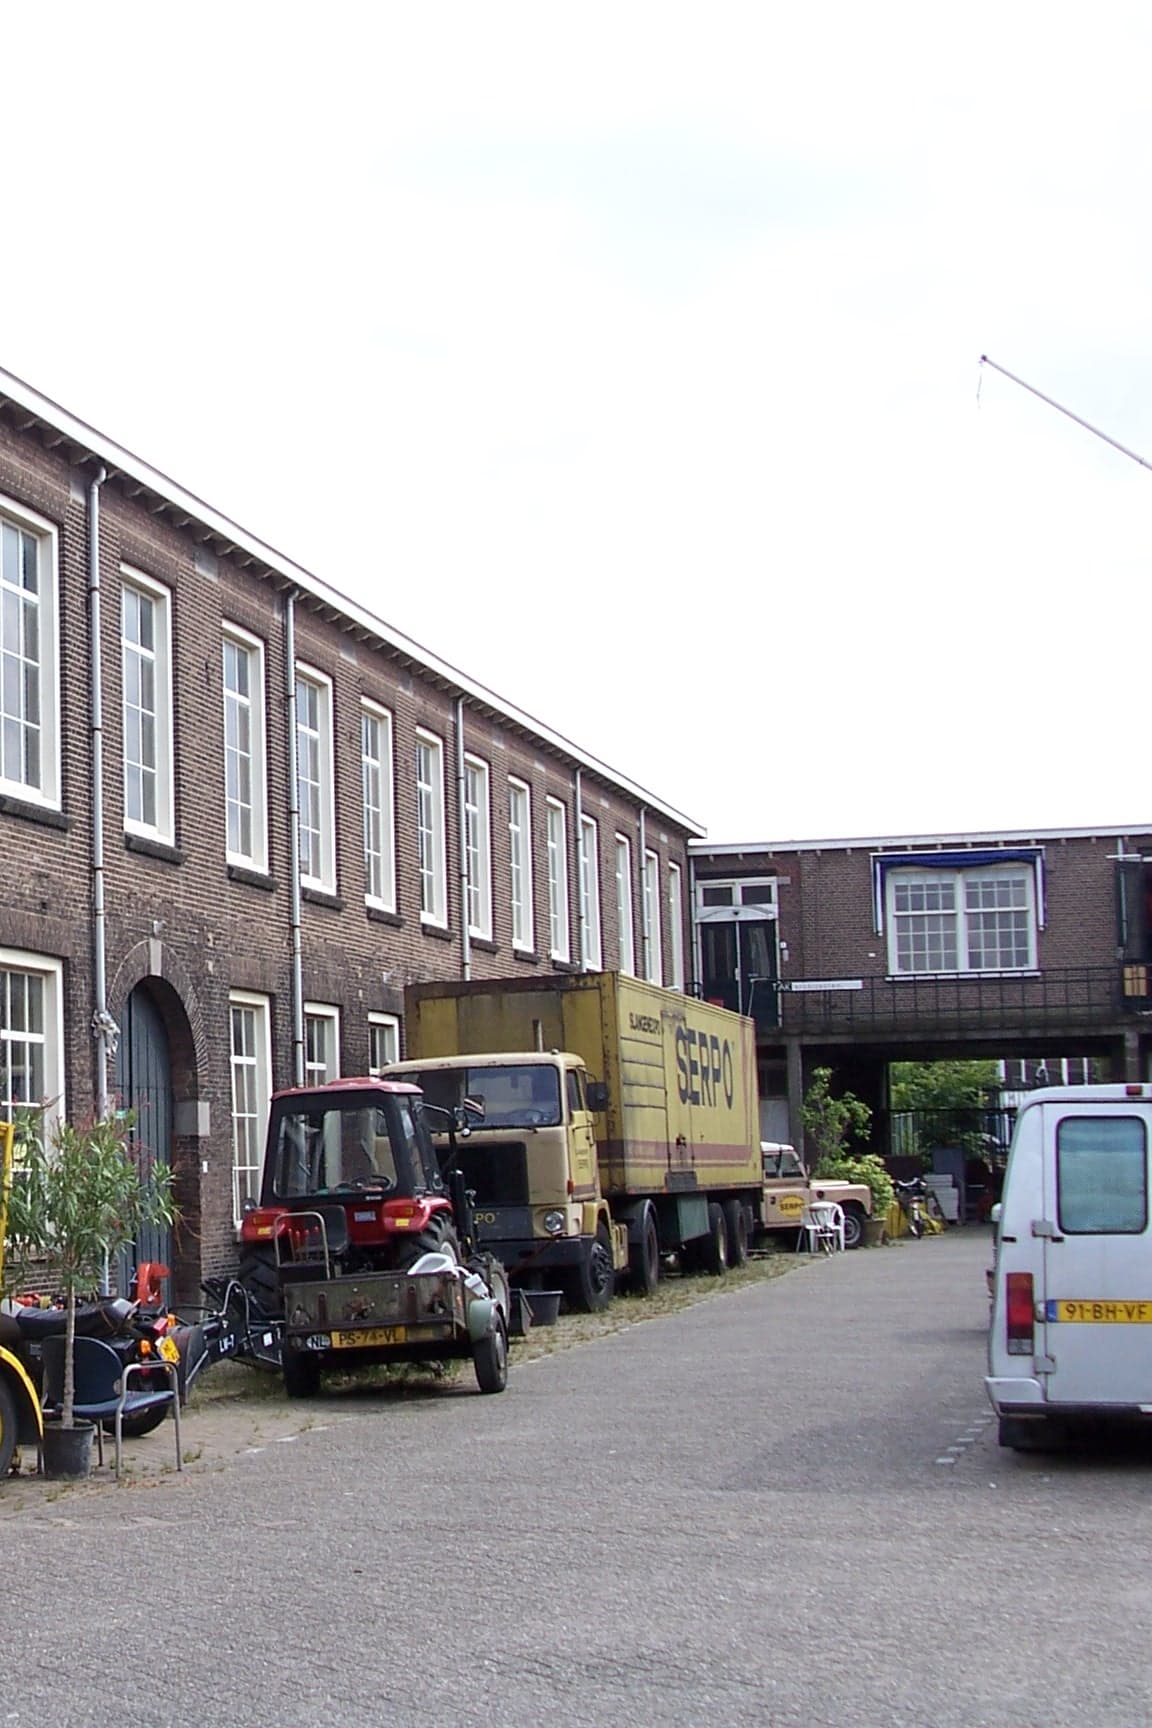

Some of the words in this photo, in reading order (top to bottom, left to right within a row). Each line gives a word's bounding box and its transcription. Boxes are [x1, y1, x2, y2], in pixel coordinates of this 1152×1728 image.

[676, 1025, 733, 1110] SERPO
[1065, 1303, 1148, 1320] 91-BH-VF
[311, 1336, 327, 1349] NL
